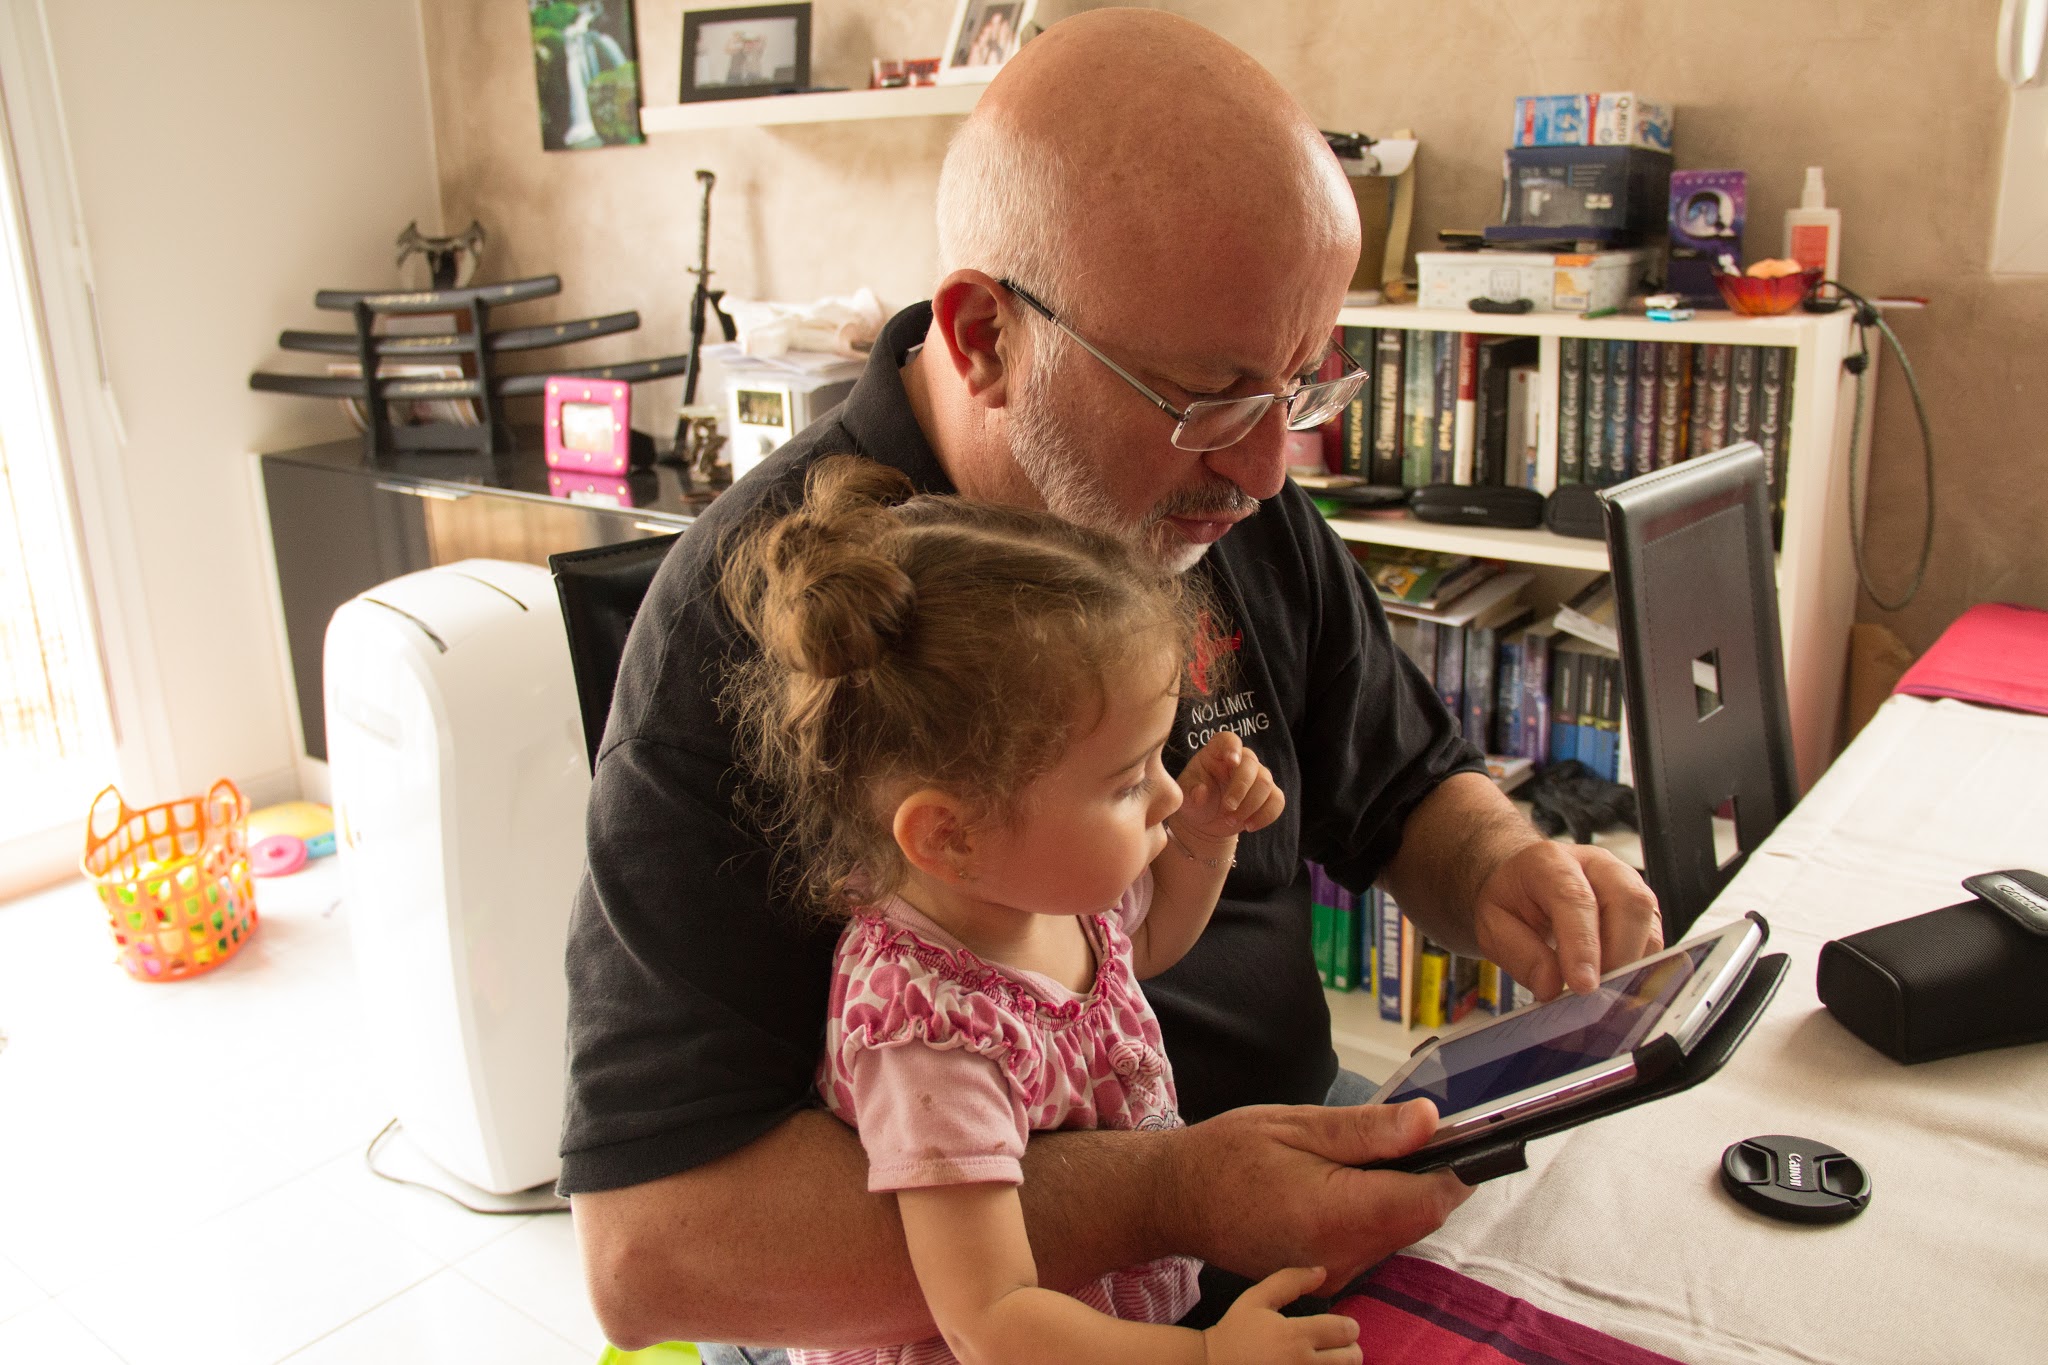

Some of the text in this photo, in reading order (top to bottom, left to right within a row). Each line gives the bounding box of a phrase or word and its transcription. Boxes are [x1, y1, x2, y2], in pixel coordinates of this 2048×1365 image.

[1191, 691, 1255, 725] NO LIMIT
[1187, 712, 1270, 750] COHING
[1995, 884, 2047, 914] Canon
[1788, 1152, 1803, 1187] Canon
